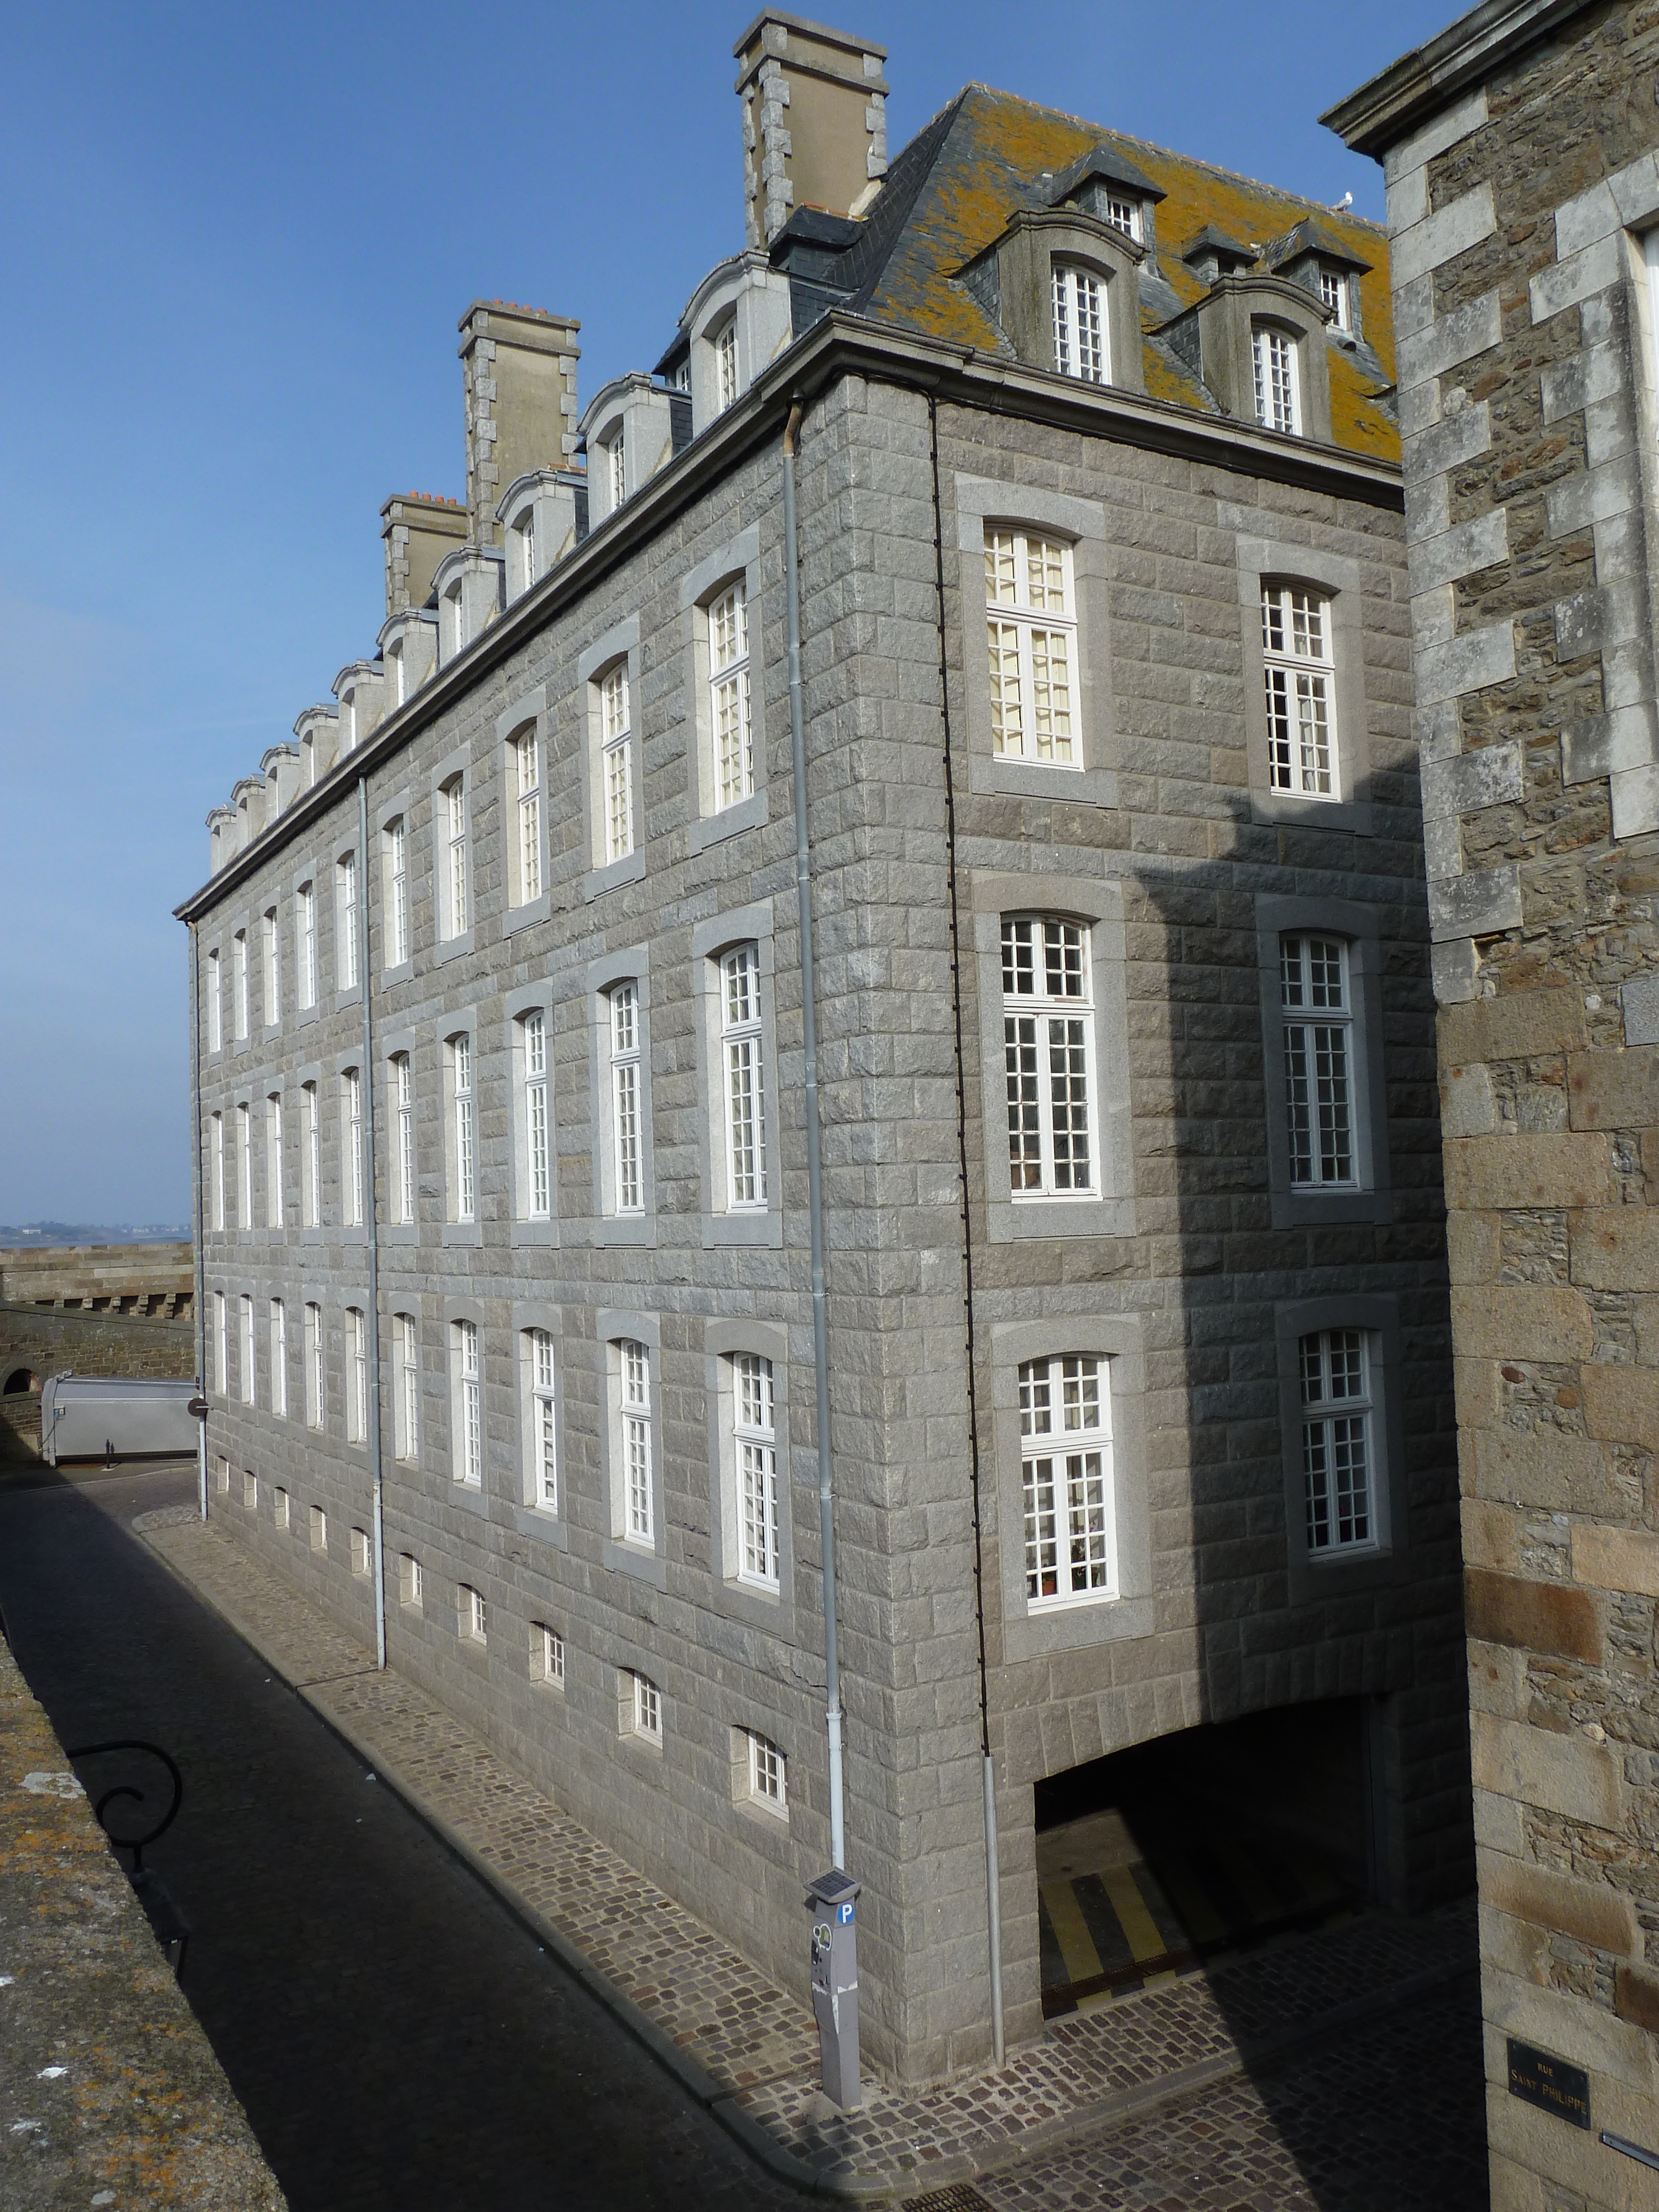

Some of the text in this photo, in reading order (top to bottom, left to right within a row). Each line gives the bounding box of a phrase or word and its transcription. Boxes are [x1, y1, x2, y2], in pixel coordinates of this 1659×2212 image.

[842, 1904, 852, 1923] P
[1538, 2063, 1553, 2077] RUE
[1542, 2084, 1587, 2115] PHILIPPE
